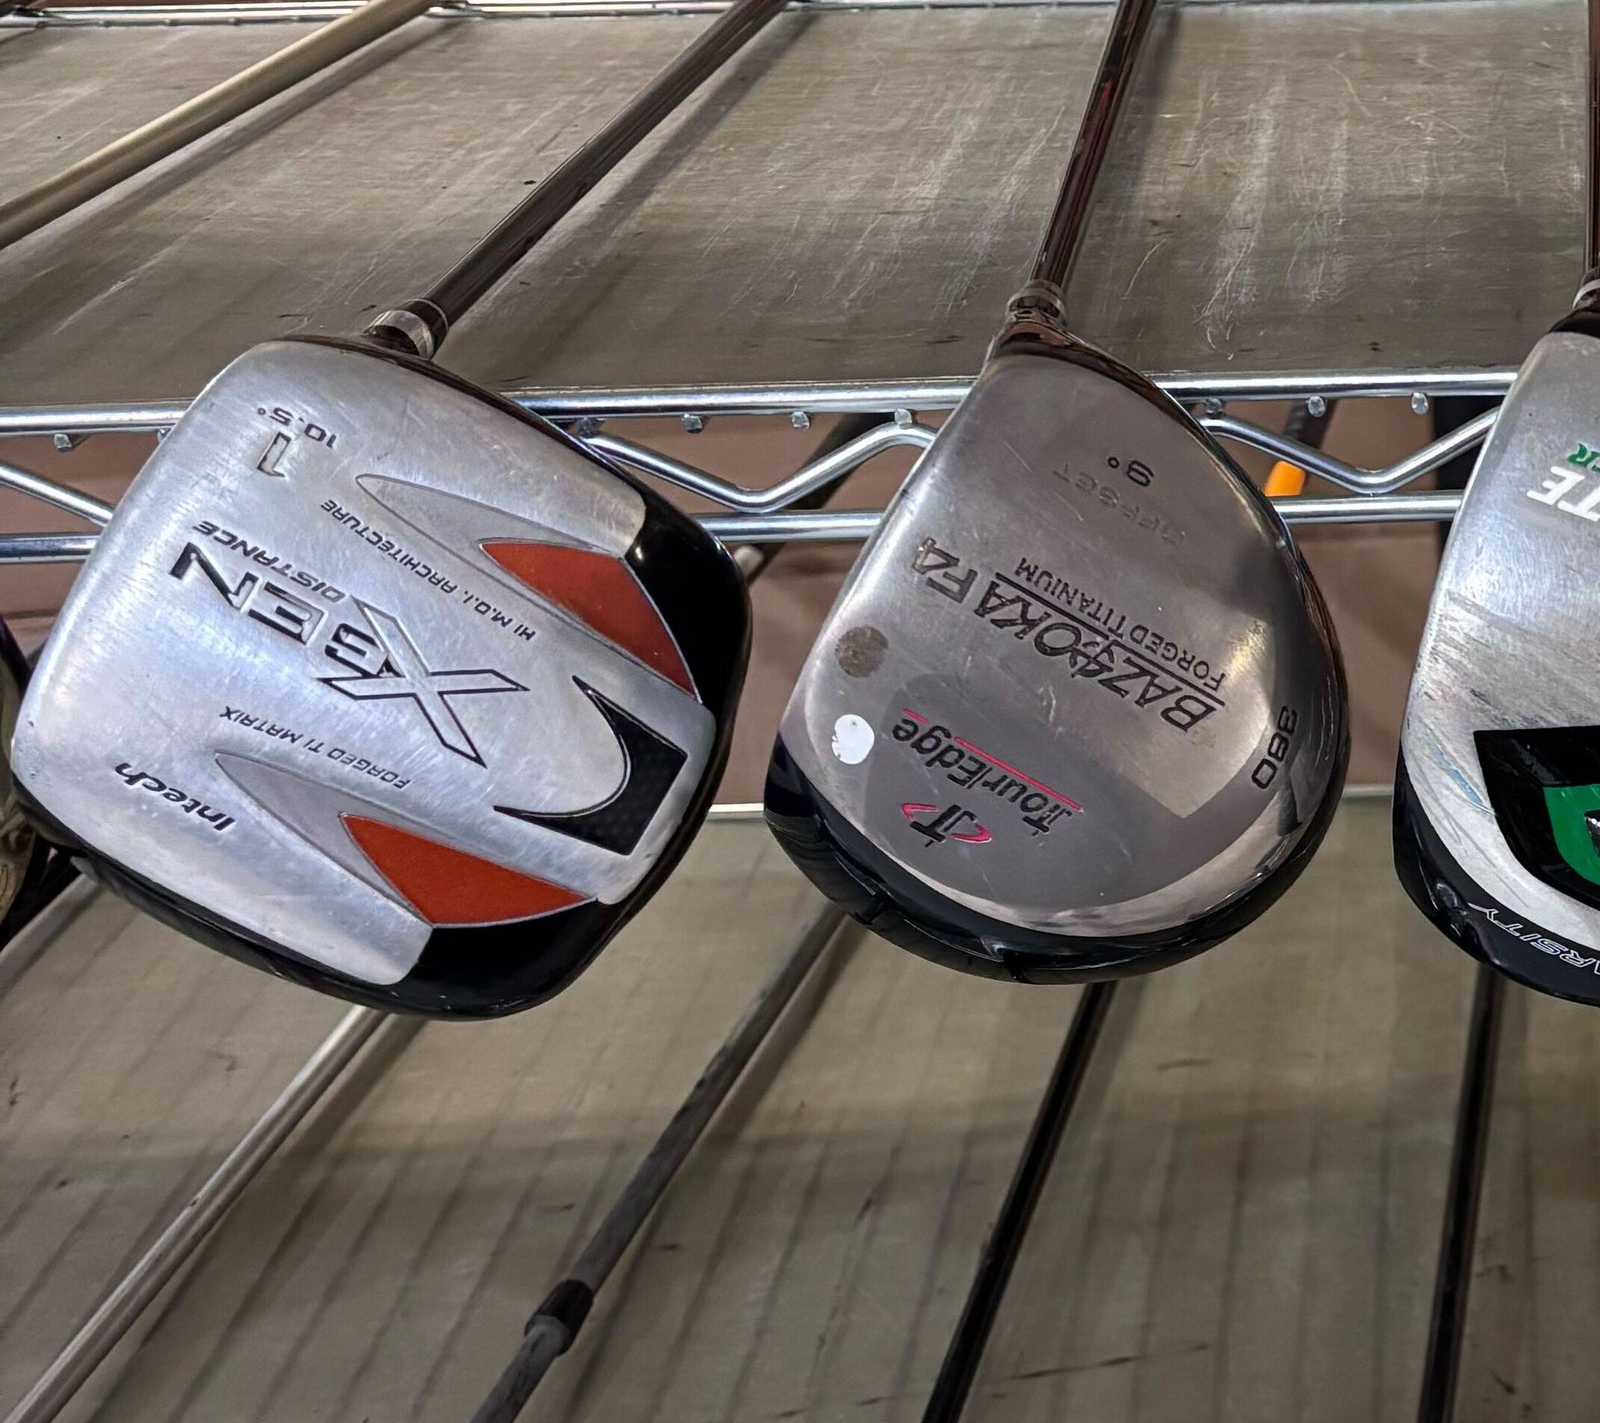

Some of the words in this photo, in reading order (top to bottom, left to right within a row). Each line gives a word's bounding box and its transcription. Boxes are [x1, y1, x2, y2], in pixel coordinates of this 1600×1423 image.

[256, 431, 291, 477] 1
[193, 520, 346, 604] DISTANCE
[320, 498, 461, 595] ARCHITECTURE
[911, 538, 973, 604] F4
[1016, 558, 1130, 646] TITANIUM
[1138, 623, 1226, 688] FORGED
[220, 706, 297, 746] MATRIX
[1251, 707, 1299, 791] 380
[114, 762, 236, 833] Intech
[328, 747, 414, 789] FORGED
